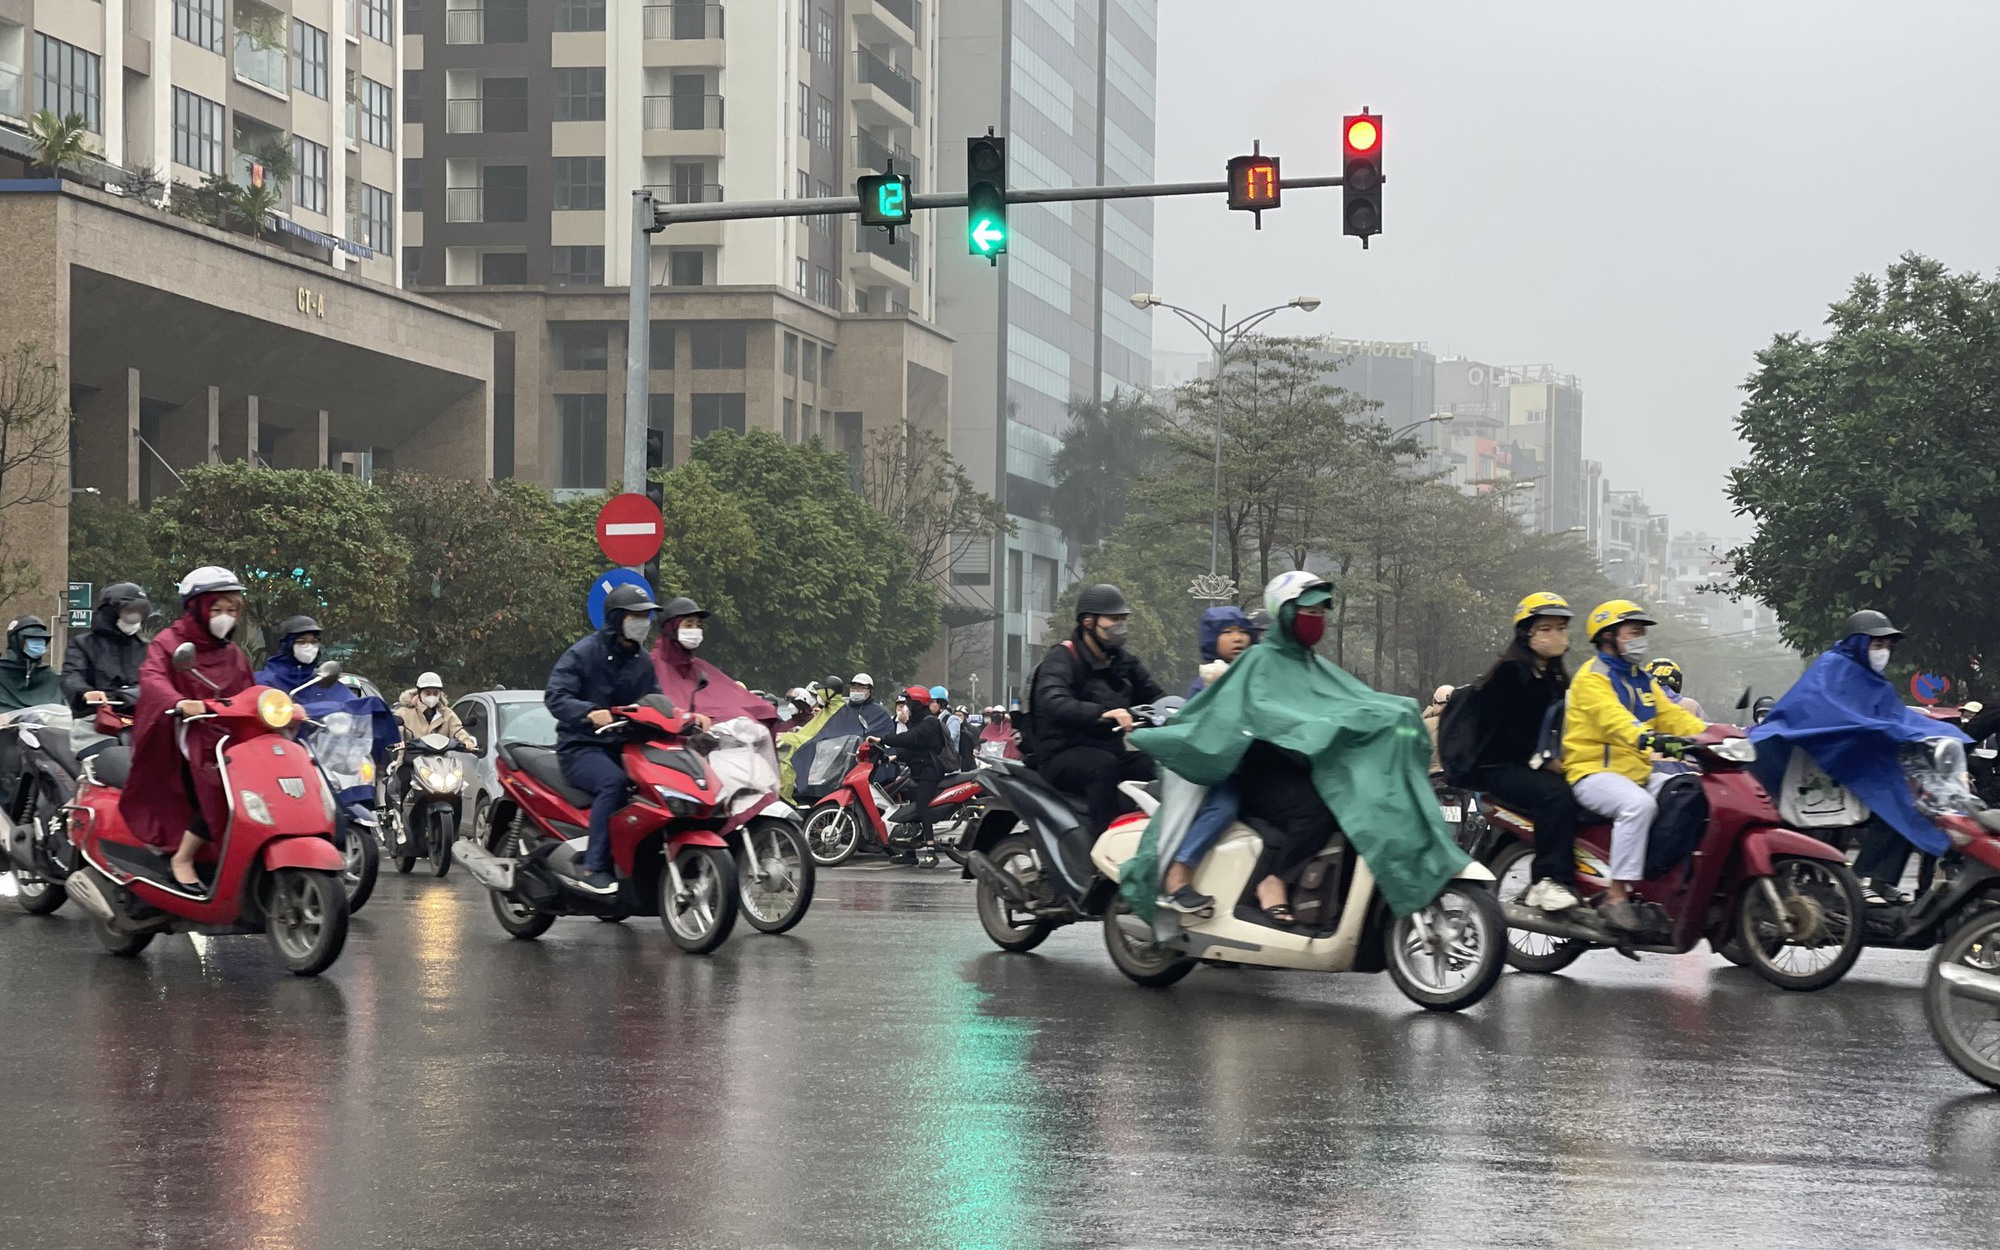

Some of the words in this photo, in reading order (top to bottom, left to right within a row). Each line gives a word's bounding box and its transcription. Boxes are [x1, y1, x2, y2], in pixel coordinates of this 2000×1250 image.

[879, 183, 903, 217] 12
[297, 286, 324, 318] CT-A
[1358, 340, 1414, 359] HOTEL
[72, 611, 87, 620] ATM
[1652, 665, 1673, 677] 46
